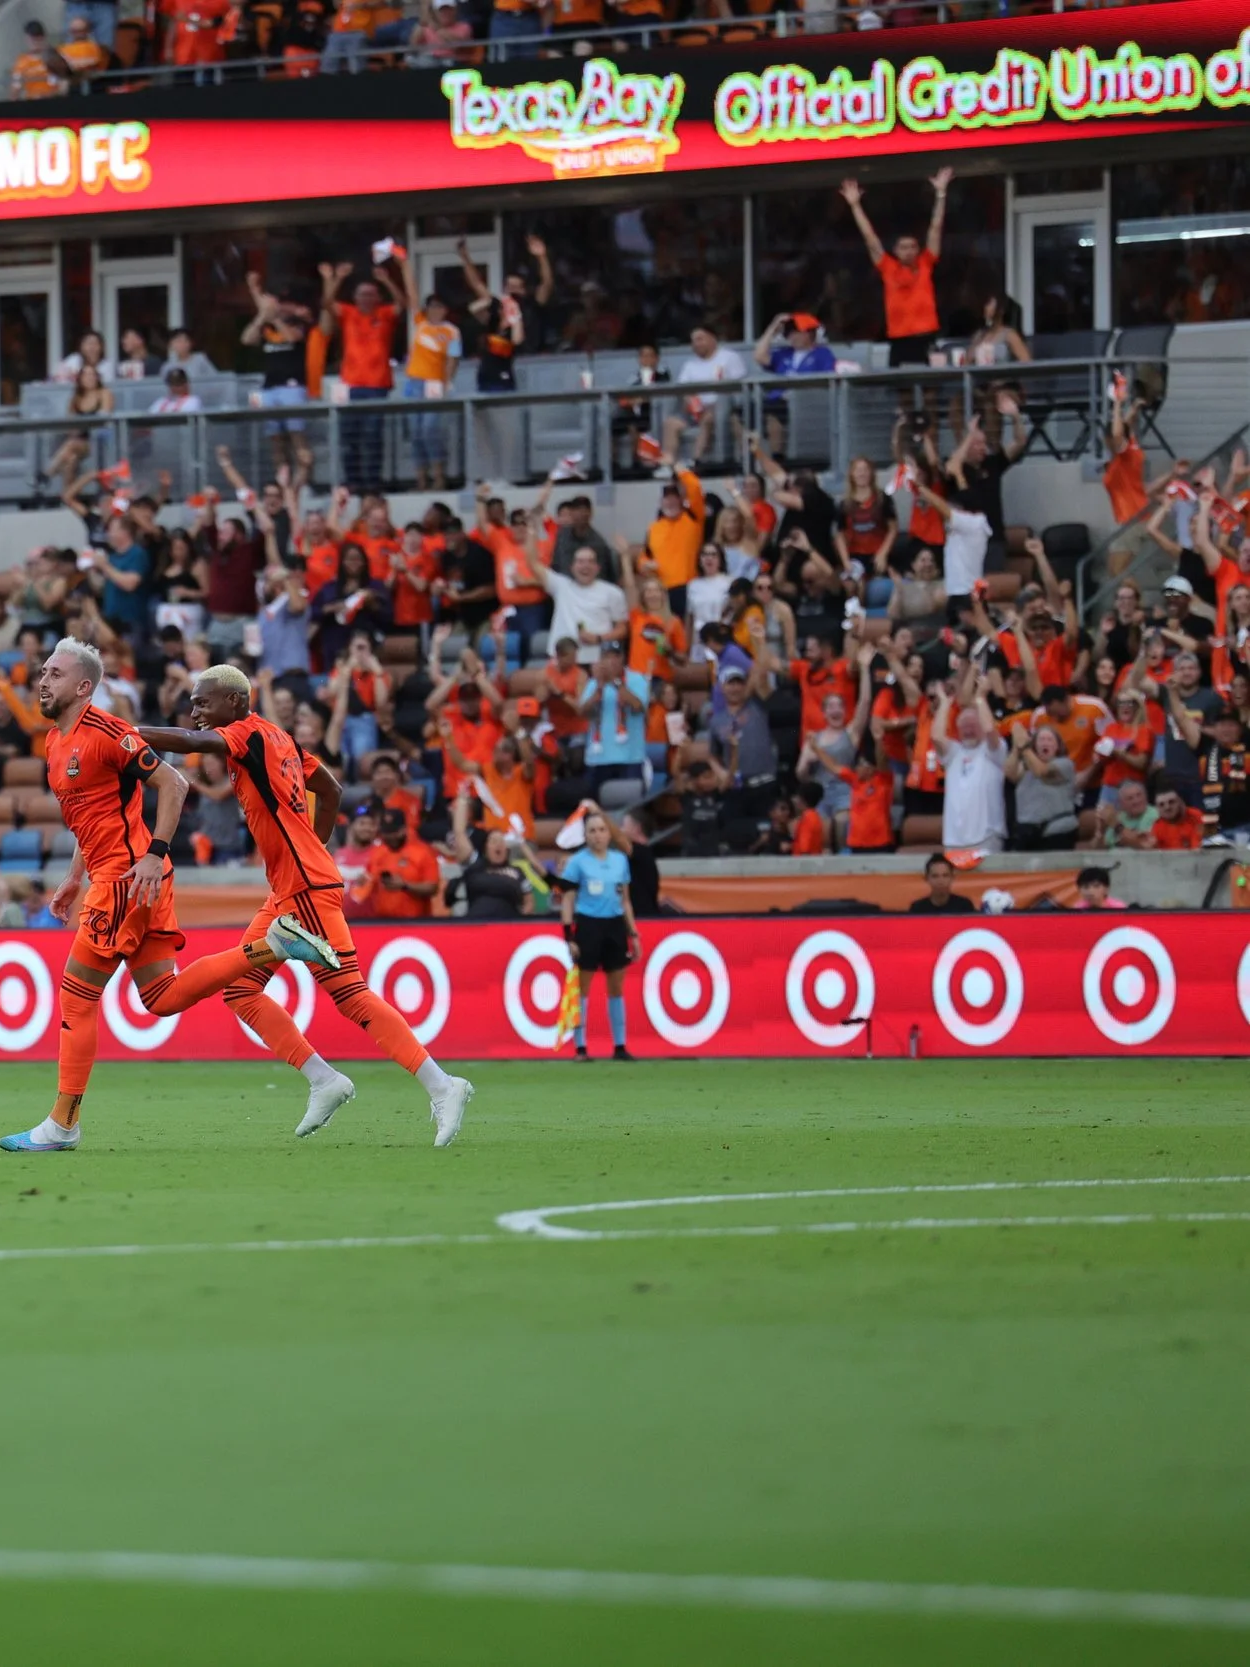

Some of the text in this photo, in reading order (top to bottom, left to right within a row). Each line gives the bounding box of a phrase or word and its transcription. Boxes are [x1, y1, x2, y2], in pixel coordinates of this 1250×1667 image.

[443, 59, 677, 138] Texas Bay
[716, 60, 886, 134] Official
[899, 49, 1039, 118] Credit
[1051, 45, 1192, 107] Union
[79, 122, 146, 183] FC
[138, 749, 159, 771] C
